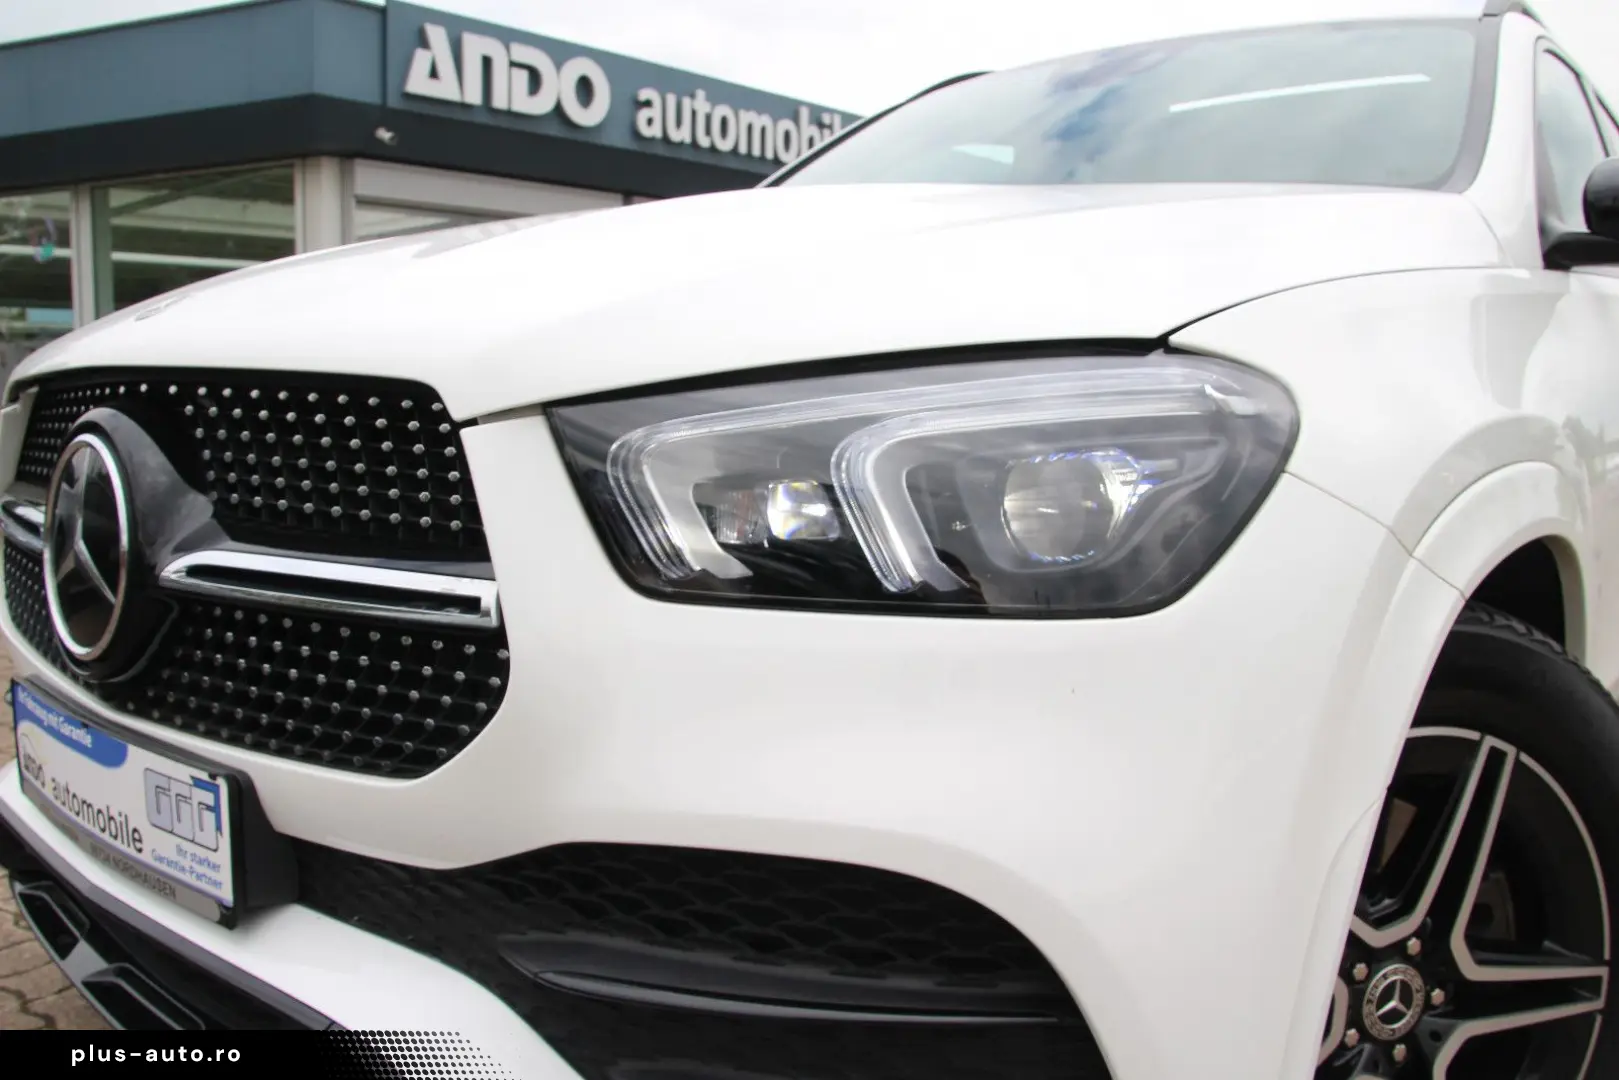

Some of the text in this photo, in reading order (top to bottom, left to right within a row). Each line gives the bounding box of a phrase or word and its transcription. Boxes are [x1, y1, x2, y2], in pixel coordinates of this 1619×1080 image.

[404, 22, 611, 128] ANDO
[60, 716, 93, 748] Garantie
[51, 777, 143, 853] automobile
[151, 848, 223, 890] Garantie-Partner
[175, 843, 222, 874] Ihr starker
